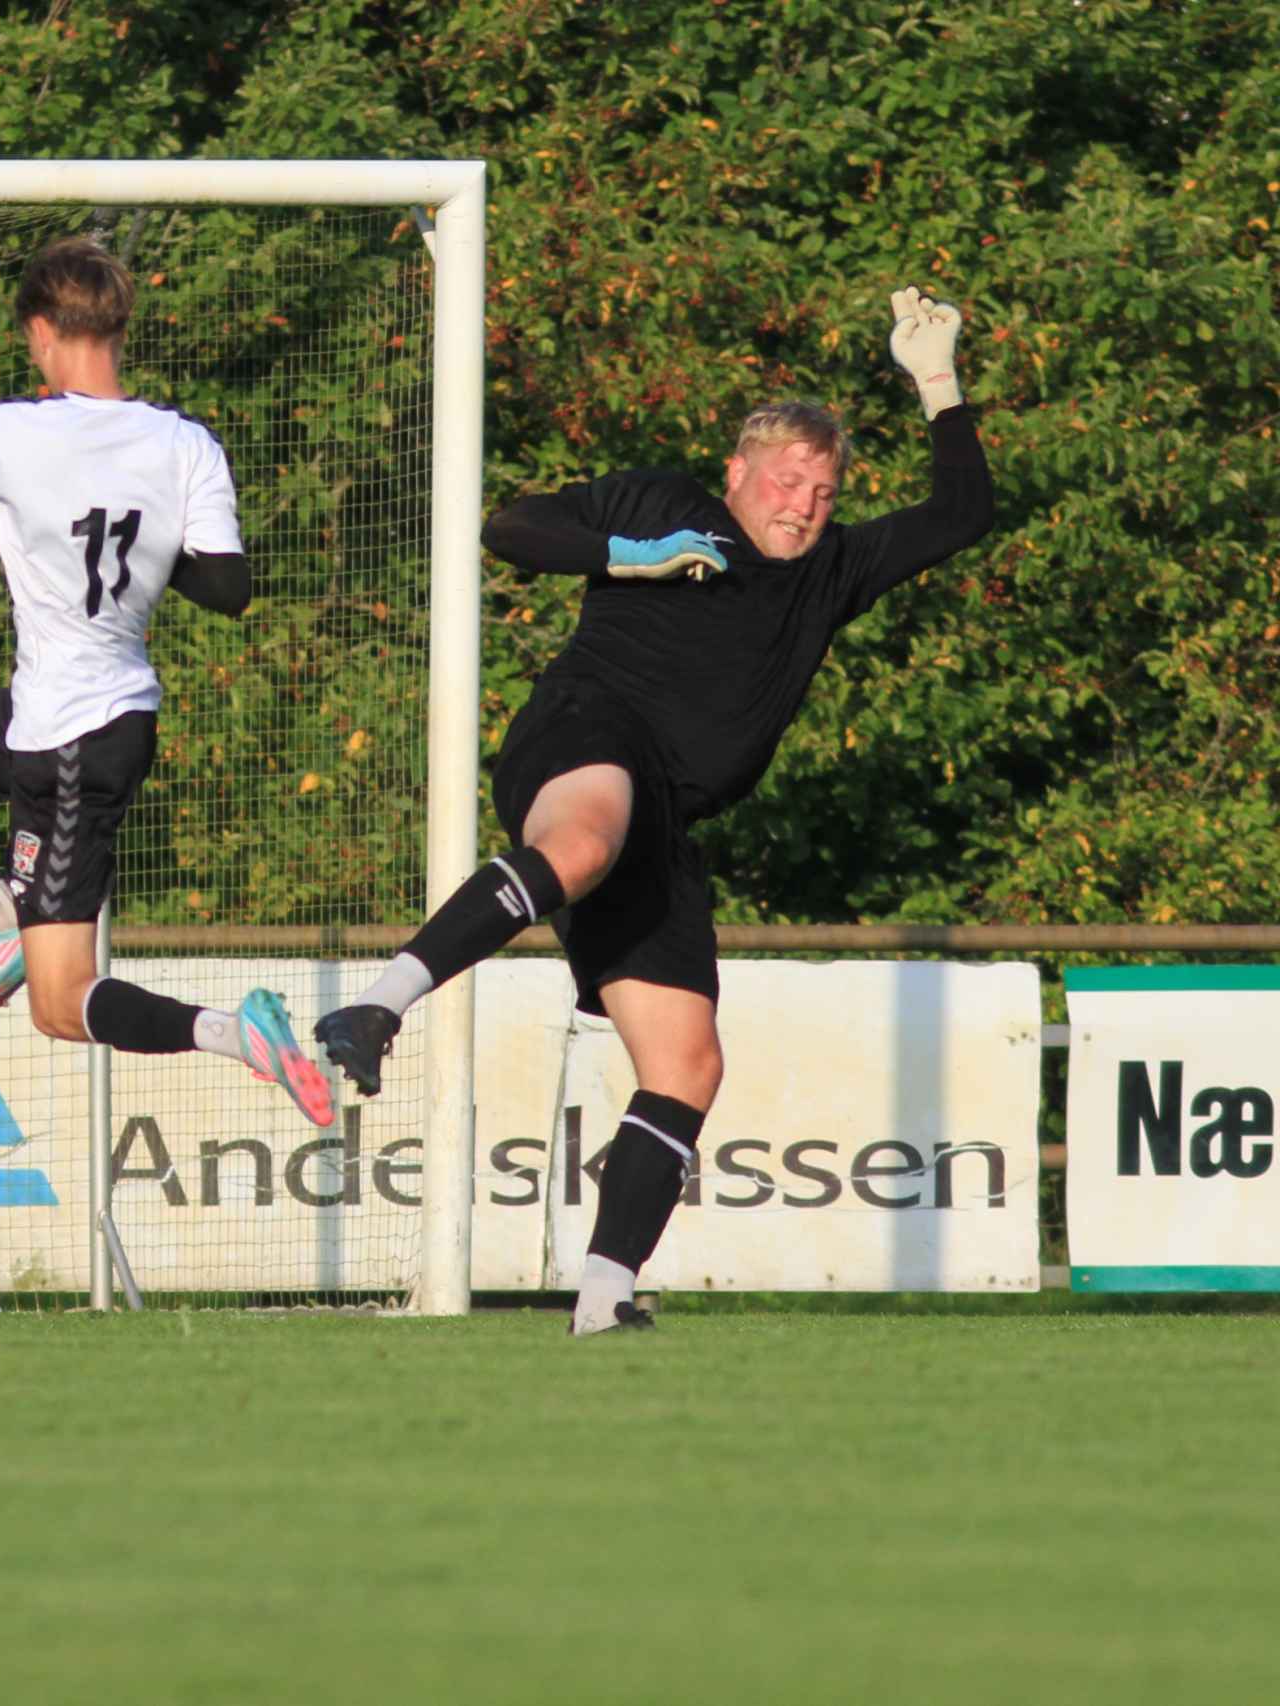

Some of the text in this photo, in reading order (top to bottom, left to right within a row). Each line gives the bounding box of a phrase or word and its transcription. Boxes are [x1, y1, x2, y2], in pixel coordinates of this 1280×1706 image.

[72, 508, 142, 618] 11
[111, 1104, 1006, 1208] Andeskssen
[1118, 1061, 1274, 1178] Næ
